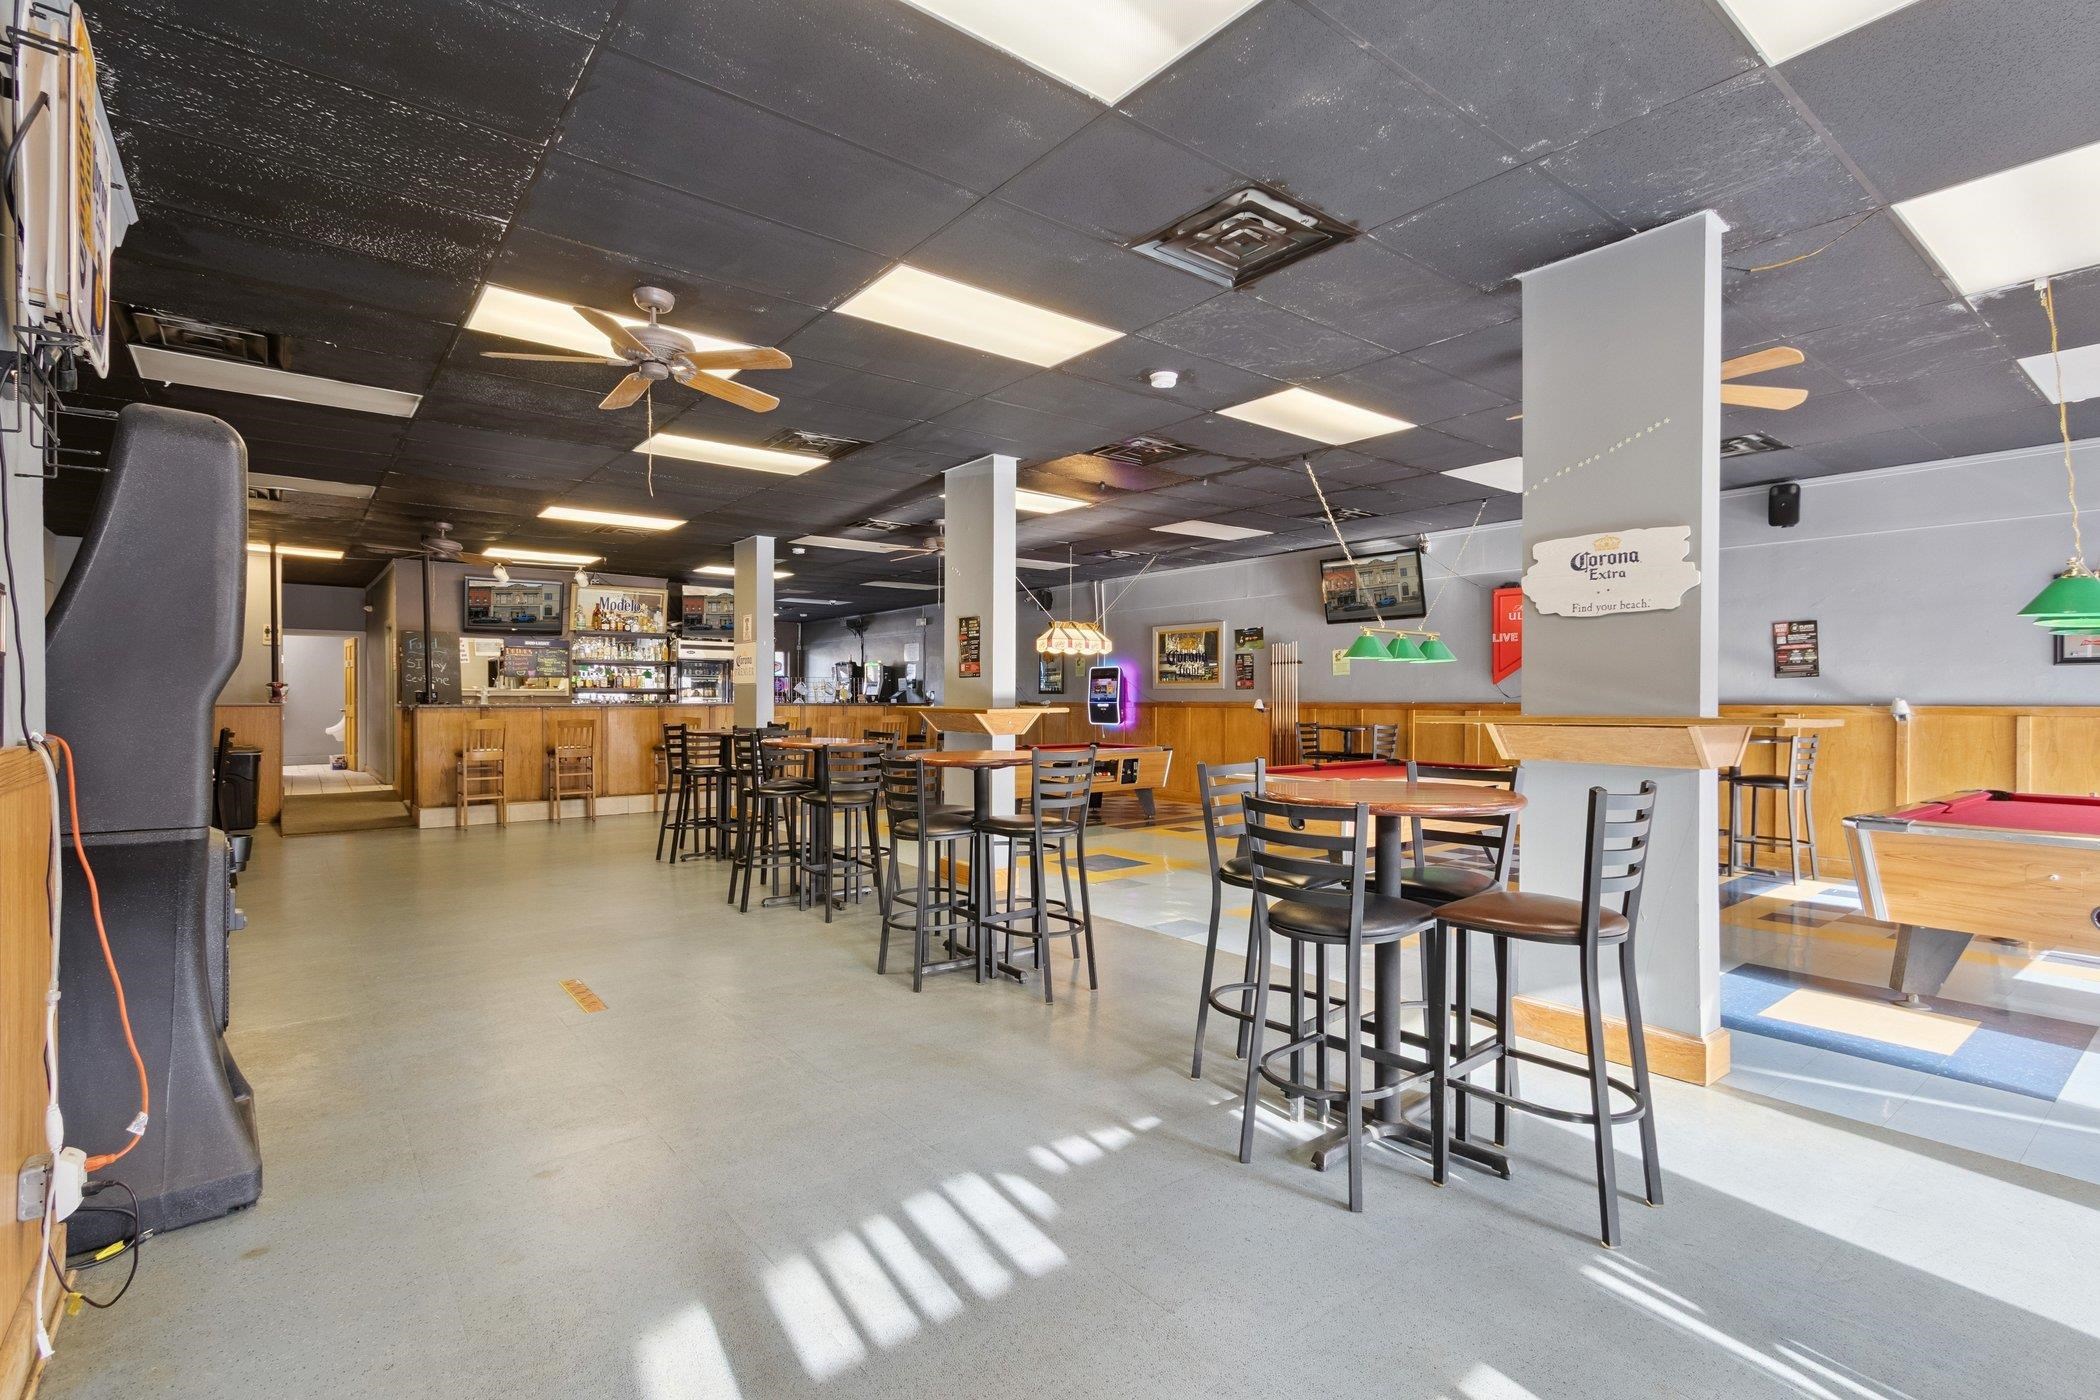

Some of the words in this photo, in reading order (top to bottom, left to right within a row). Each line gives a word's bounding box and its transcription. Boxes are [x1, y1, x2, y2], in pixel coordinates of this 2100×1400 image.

[1570, 551, 1640, 573] Corona
[1589, 567, 1626, 580] Extra
[600, 596, 641, 612] Modelo
[1572, 603, 1593, 613] Find
[1596, 603, 1617, 614] your
[1620, 598, 1651, 610] beach.
[1492, 632, 1519, 643] LIVE
